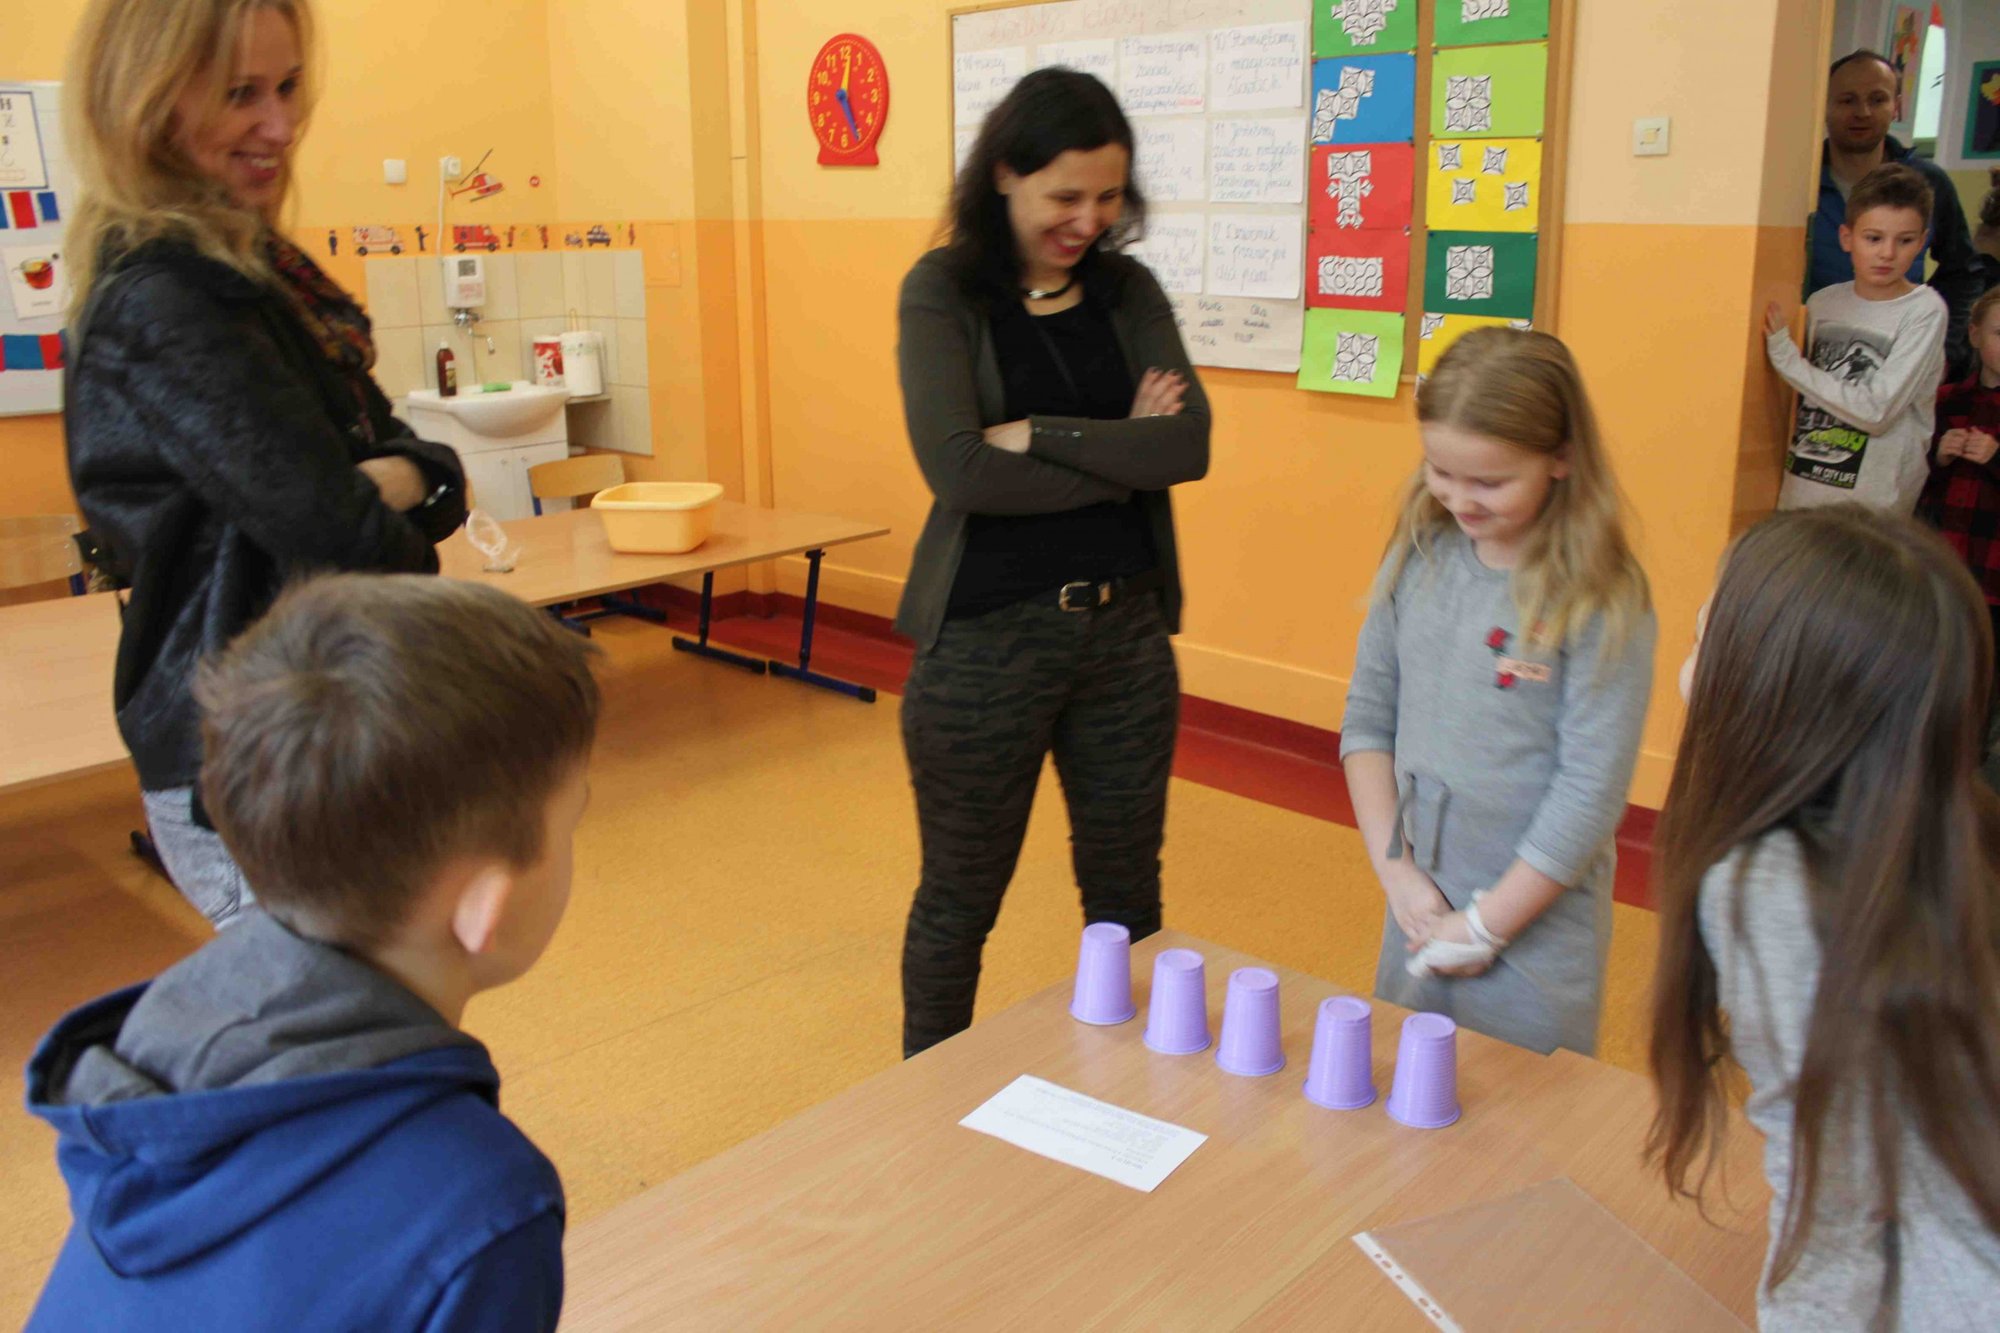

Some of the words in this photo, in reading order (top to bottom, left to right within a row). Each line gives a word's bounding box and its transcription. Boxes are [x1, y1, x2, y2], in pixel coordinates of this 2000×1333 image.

[840, 45, 851, 60] 12
[856, 51, 862, 66] 1
[826, 54, 836, 68] 11
[817, 70, 828, 86] 10
[867, 68, 875, 83] 2
[813, 91, 820, 106] 9
[870, 88, 879, 103] 3
[817, 113, 825, 128] 8
[865, 112, 873, 126] 4
[828, 128, 835, 143] 7
[841, 134, 848, 148] 6
[1823, 468, 1840, 480] CITY
[1839, 472, 1857, 483] LIFE
